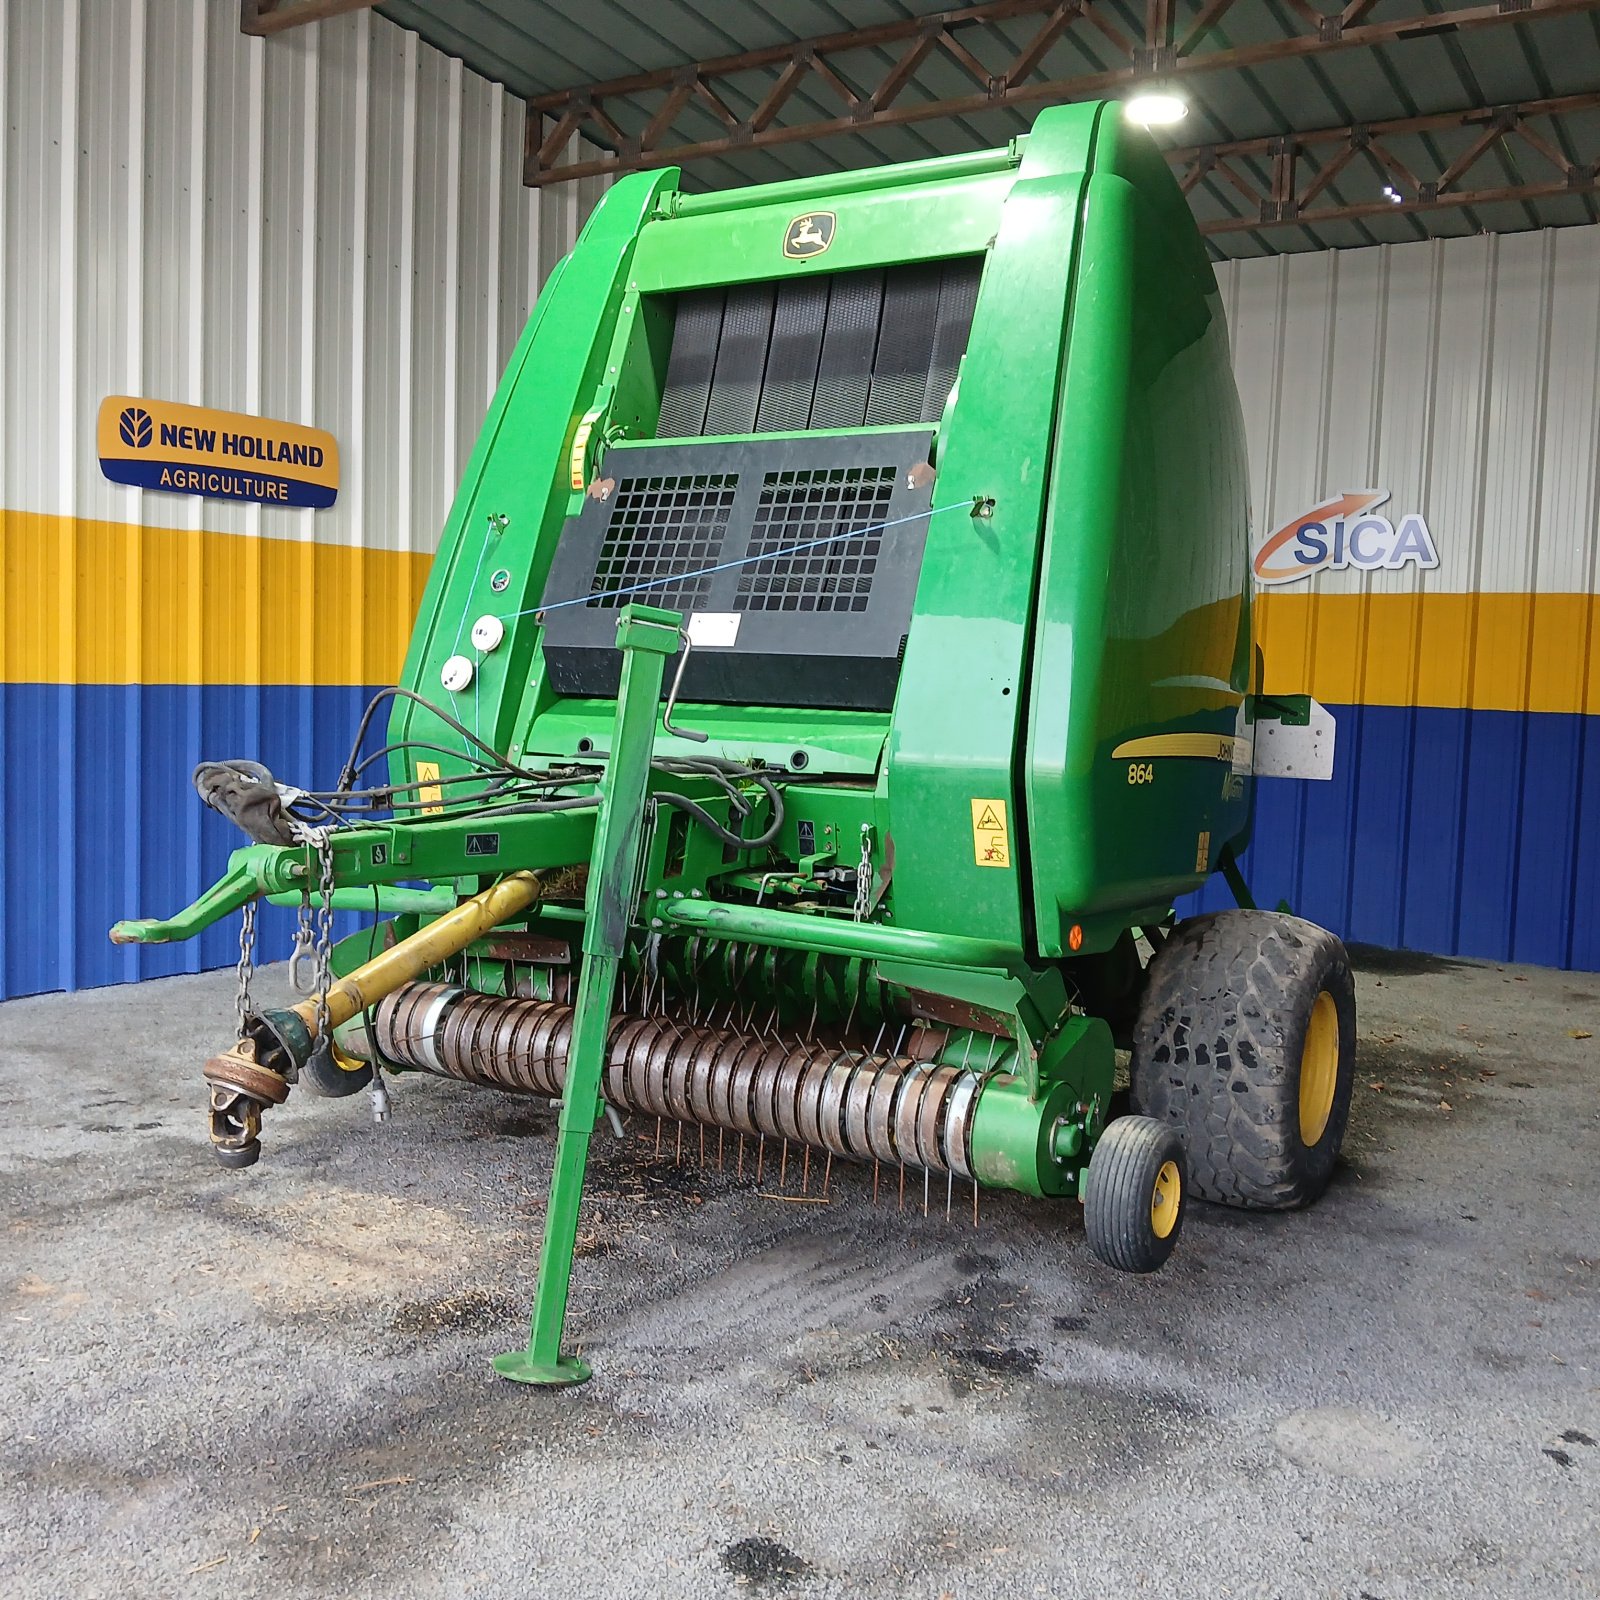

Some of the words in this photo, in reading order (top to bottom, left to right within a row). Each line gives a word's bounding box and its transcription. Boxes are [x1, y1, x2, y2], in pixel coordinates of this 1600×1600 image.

[160, 423, 216, 453] NEW
[222, 432, 324, 468] HOLLAND
[160, 468, 288, 500] AGRICULTURE
[1294, 519, 1432, 565] SICA
[1127, 763, 1153, 785] 864
